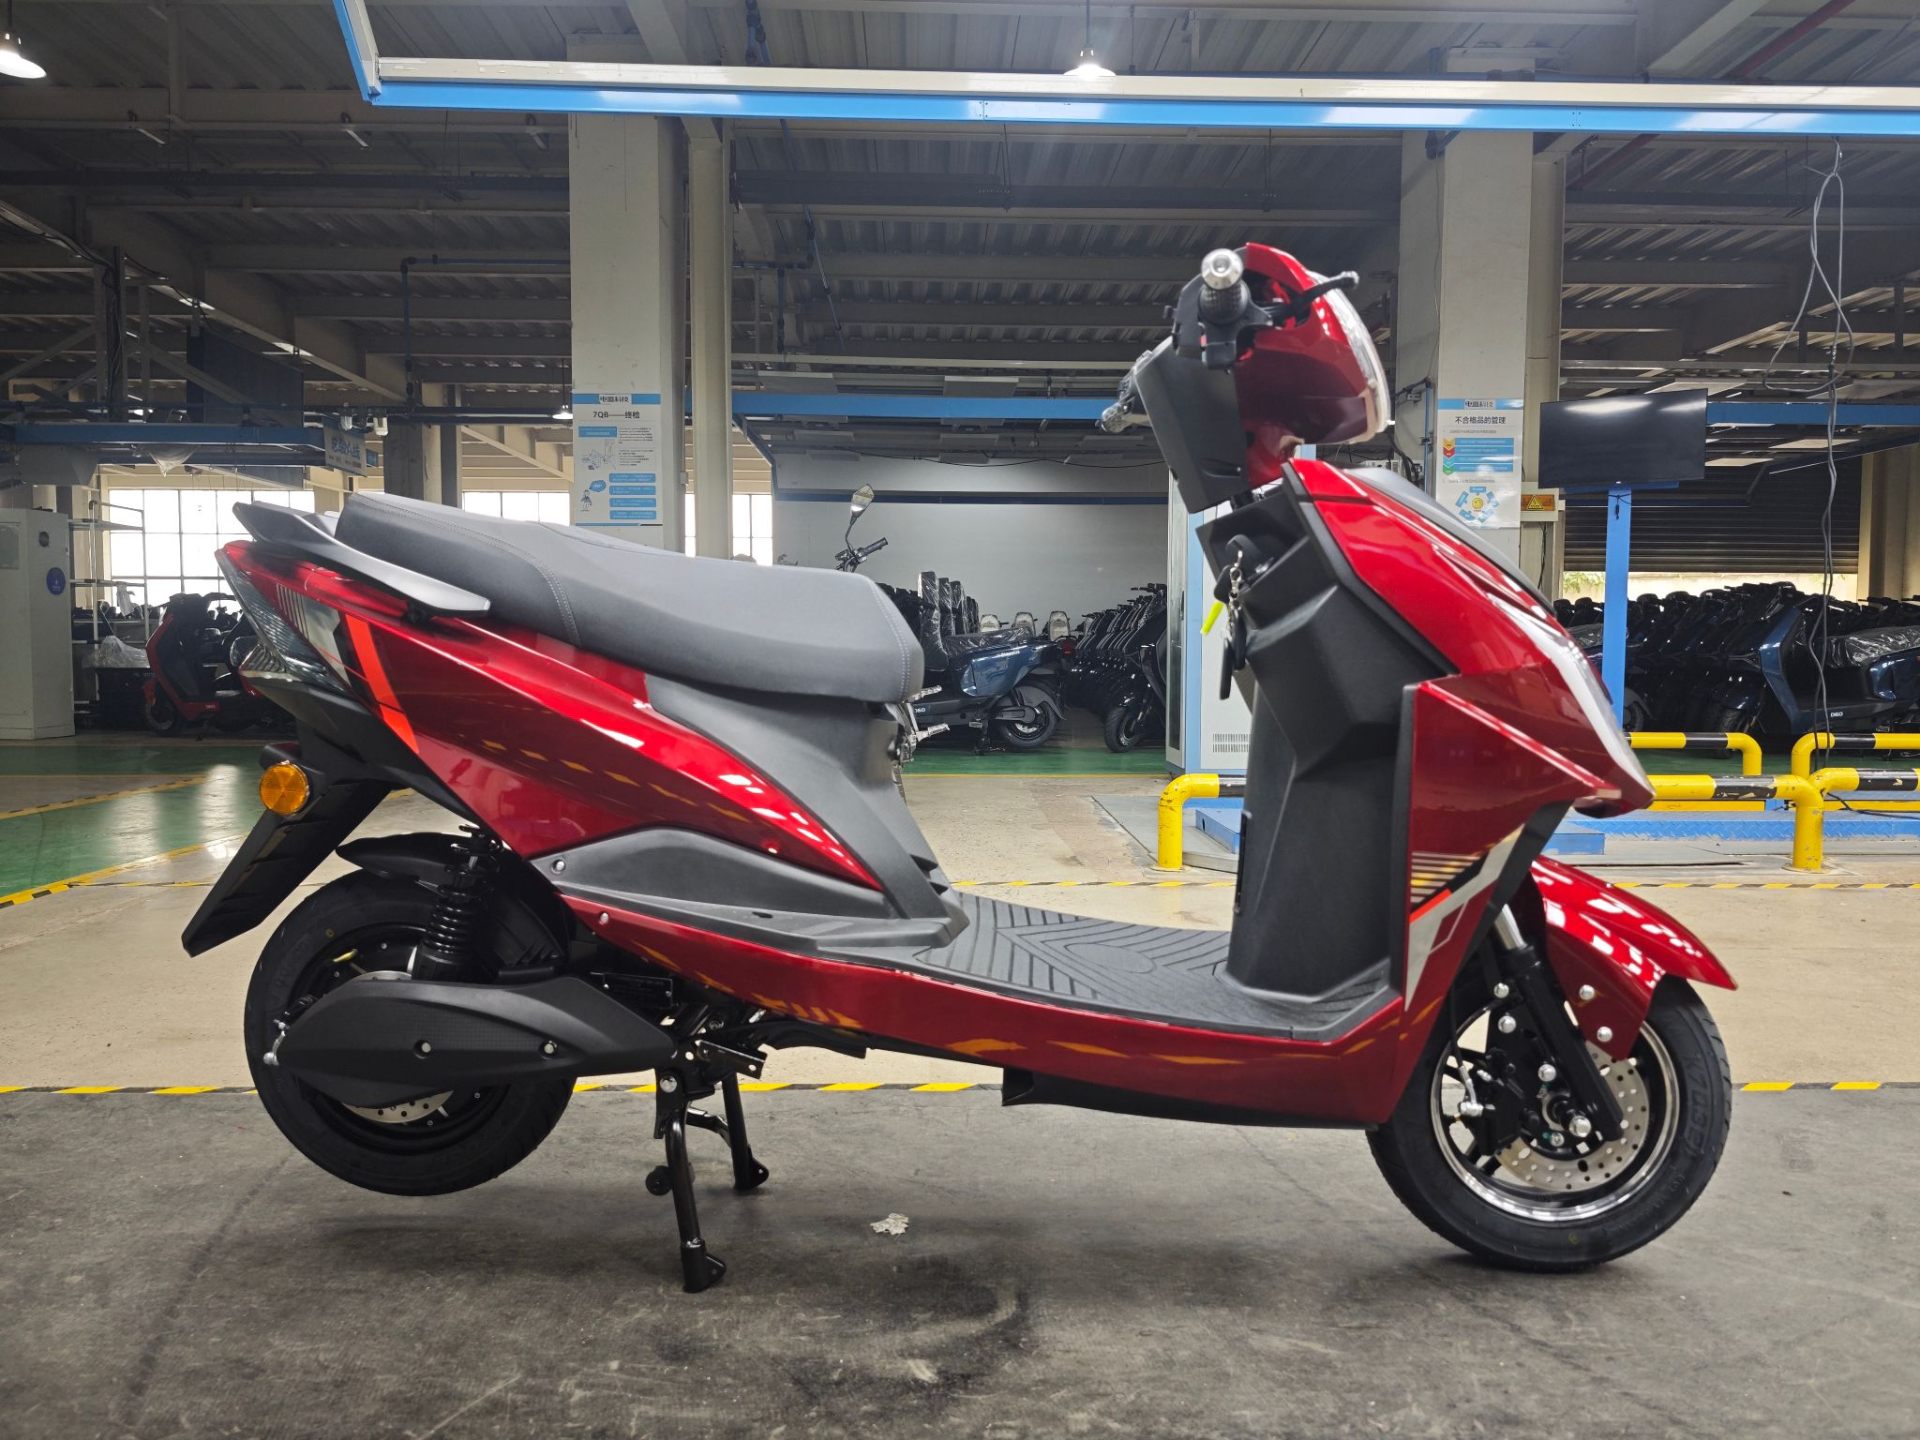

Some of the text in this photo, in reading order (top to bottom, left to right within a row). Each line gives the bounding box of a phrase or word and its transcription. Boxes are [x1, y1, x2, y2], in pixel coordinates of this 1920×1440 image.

[1455, 416, 1506, 424] 不合格品的管理
